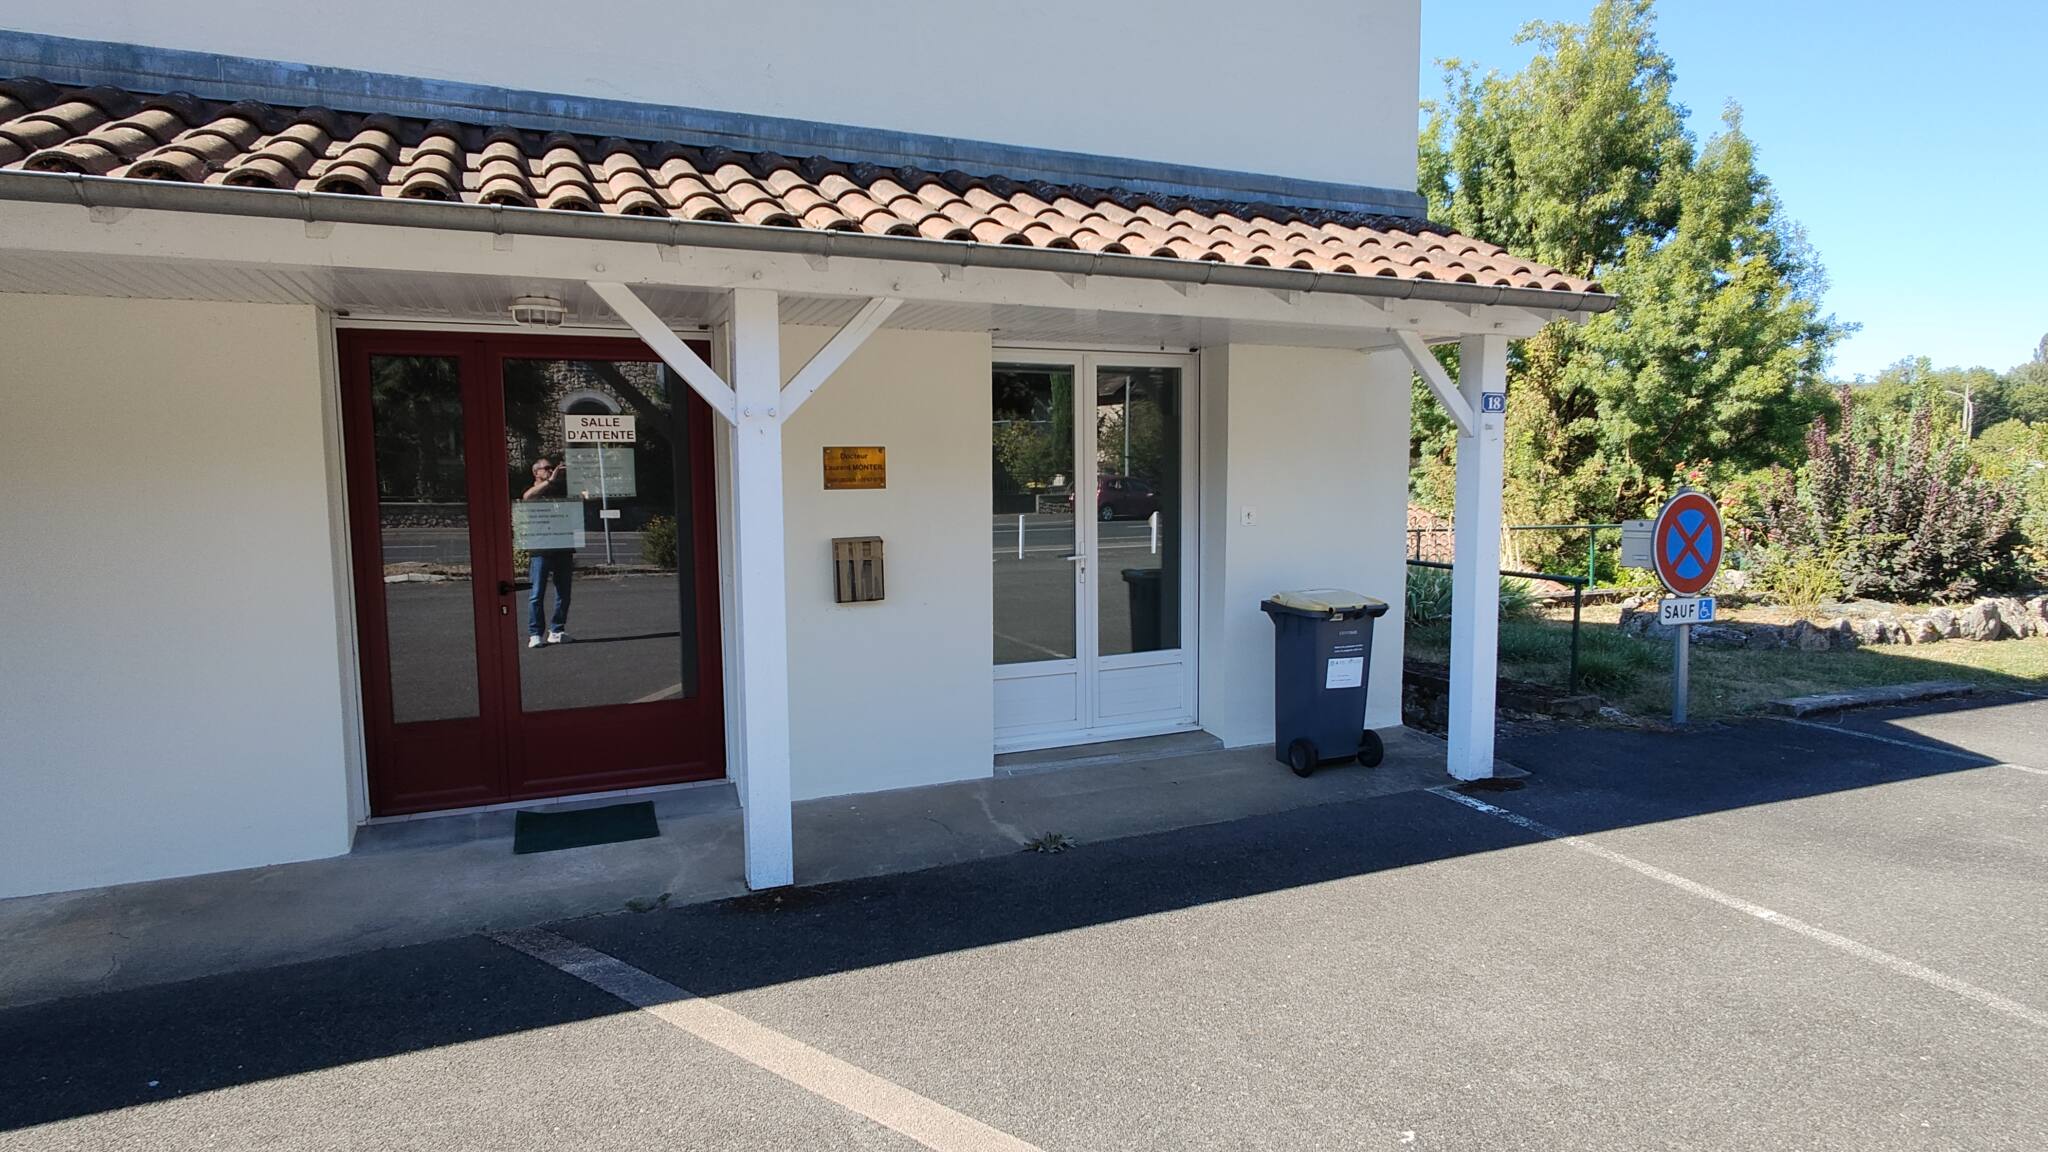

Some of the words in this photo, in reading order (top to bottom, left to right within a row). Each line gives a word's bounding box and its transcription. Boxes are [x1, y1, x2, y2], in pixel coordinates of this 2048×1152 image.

[1487, 396, 1501, 410] 18
[580, 417, 621, 427] SALLE
[567, 430, 634, 440] D'ATTENTE
[840, 452, 869, 460] Docteur
[1664, 604, 1696, 619] SAUF
